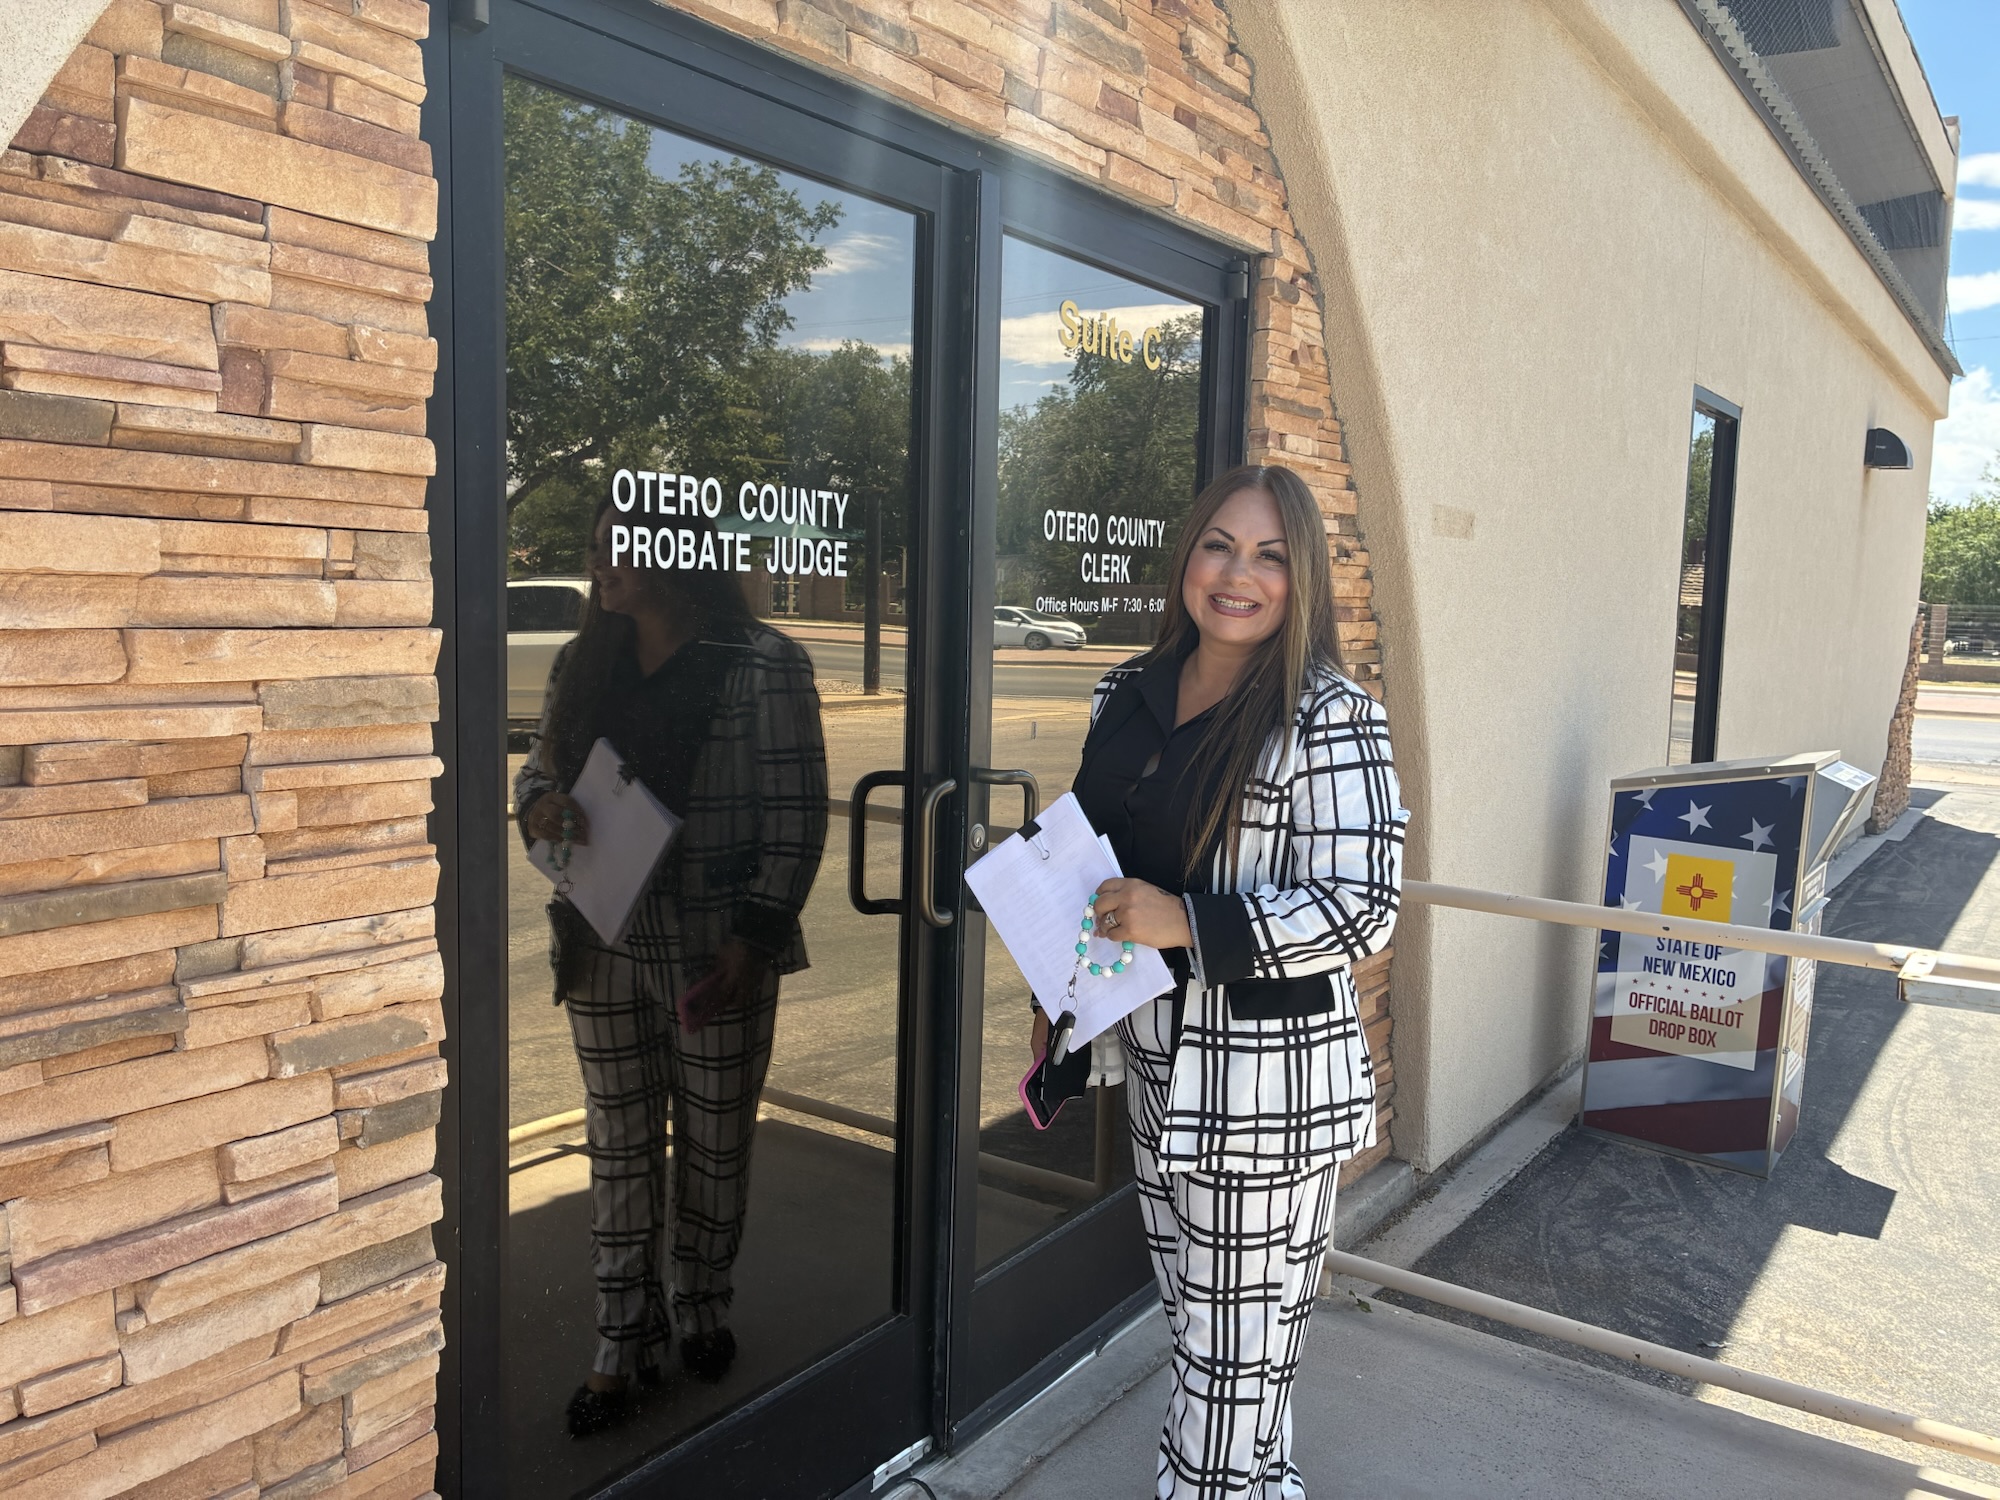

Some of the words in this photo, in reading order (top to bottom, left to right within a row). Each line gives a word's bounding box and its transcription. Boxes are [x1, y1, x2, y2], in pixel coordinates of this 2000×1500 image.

[1059, 299, 1134, 364] Suite
[1142, 326, 1162, 371] C
[612, 468, 722, 519] OTERO
[738, 481, 849, 529] COUNTY
[1043, 508, 1099, 544] OTERO
[1106, 515, 1166, 548] COUNTY
[611, 524, 751, 572] PROBATE
[766, 535, 848, 577] JUDGE
[1081, 552, 1132, 584] CLERK
[1035, 596, 1067, 613] Office
[1069, 597, 1099, 613] Hours
[1101, 597, 1119, 613] M-F
[1123, 597, 1142, 613] 7:30
[1656, 937, 1700, 958] STATE
[1704, 943, 1724, 961] OF
[1643, 955, 1676, 977] NEW
[1679, 962, 1736, 988] MEXICO
[1628, 991, 1687, 1018] OFFICIAL
[1690, 1003, 1744, 1029] BALLOT
[1648, 1019, 1686, 1041] DROP
[1688, 1026, 1718, 1048] BOX
